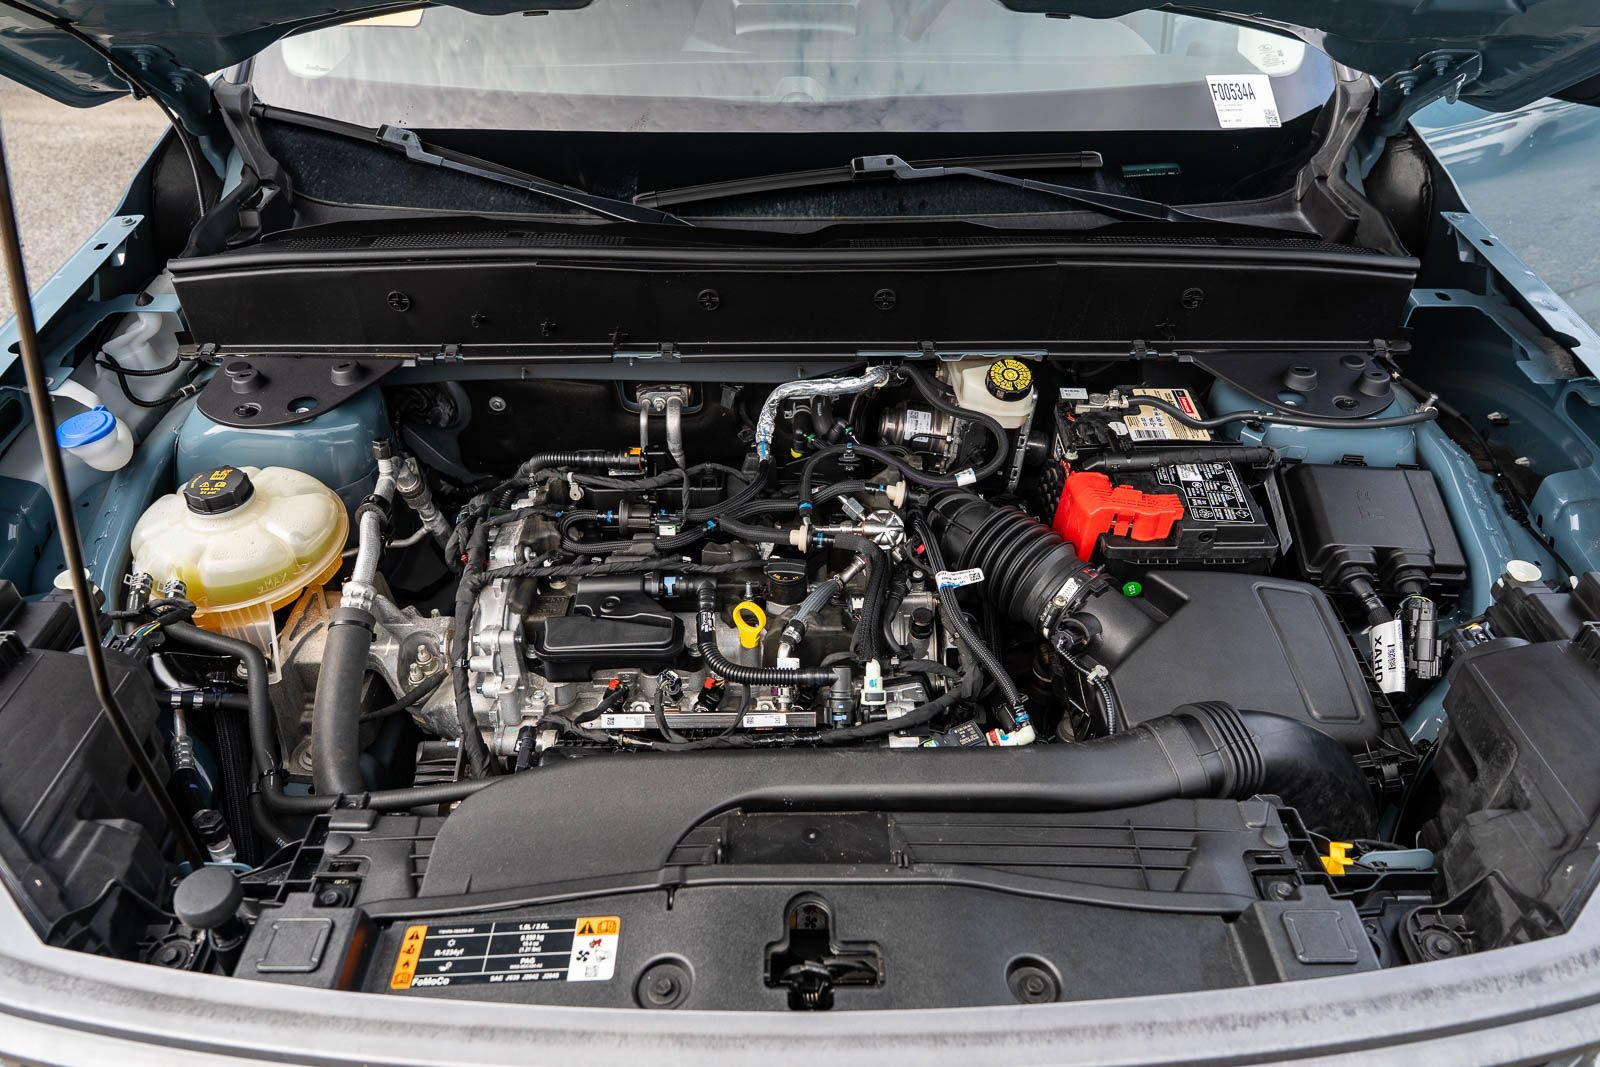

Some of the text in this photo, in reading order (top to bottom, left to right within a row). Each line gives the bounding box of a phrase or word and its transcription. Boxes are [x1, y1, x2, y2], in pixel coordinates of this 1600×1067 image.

[1211, 82, 1256, 101] F00534A
[1374, 636, 1384, 682] XAHD
[411, 976, 450, 987] FoMoCo
